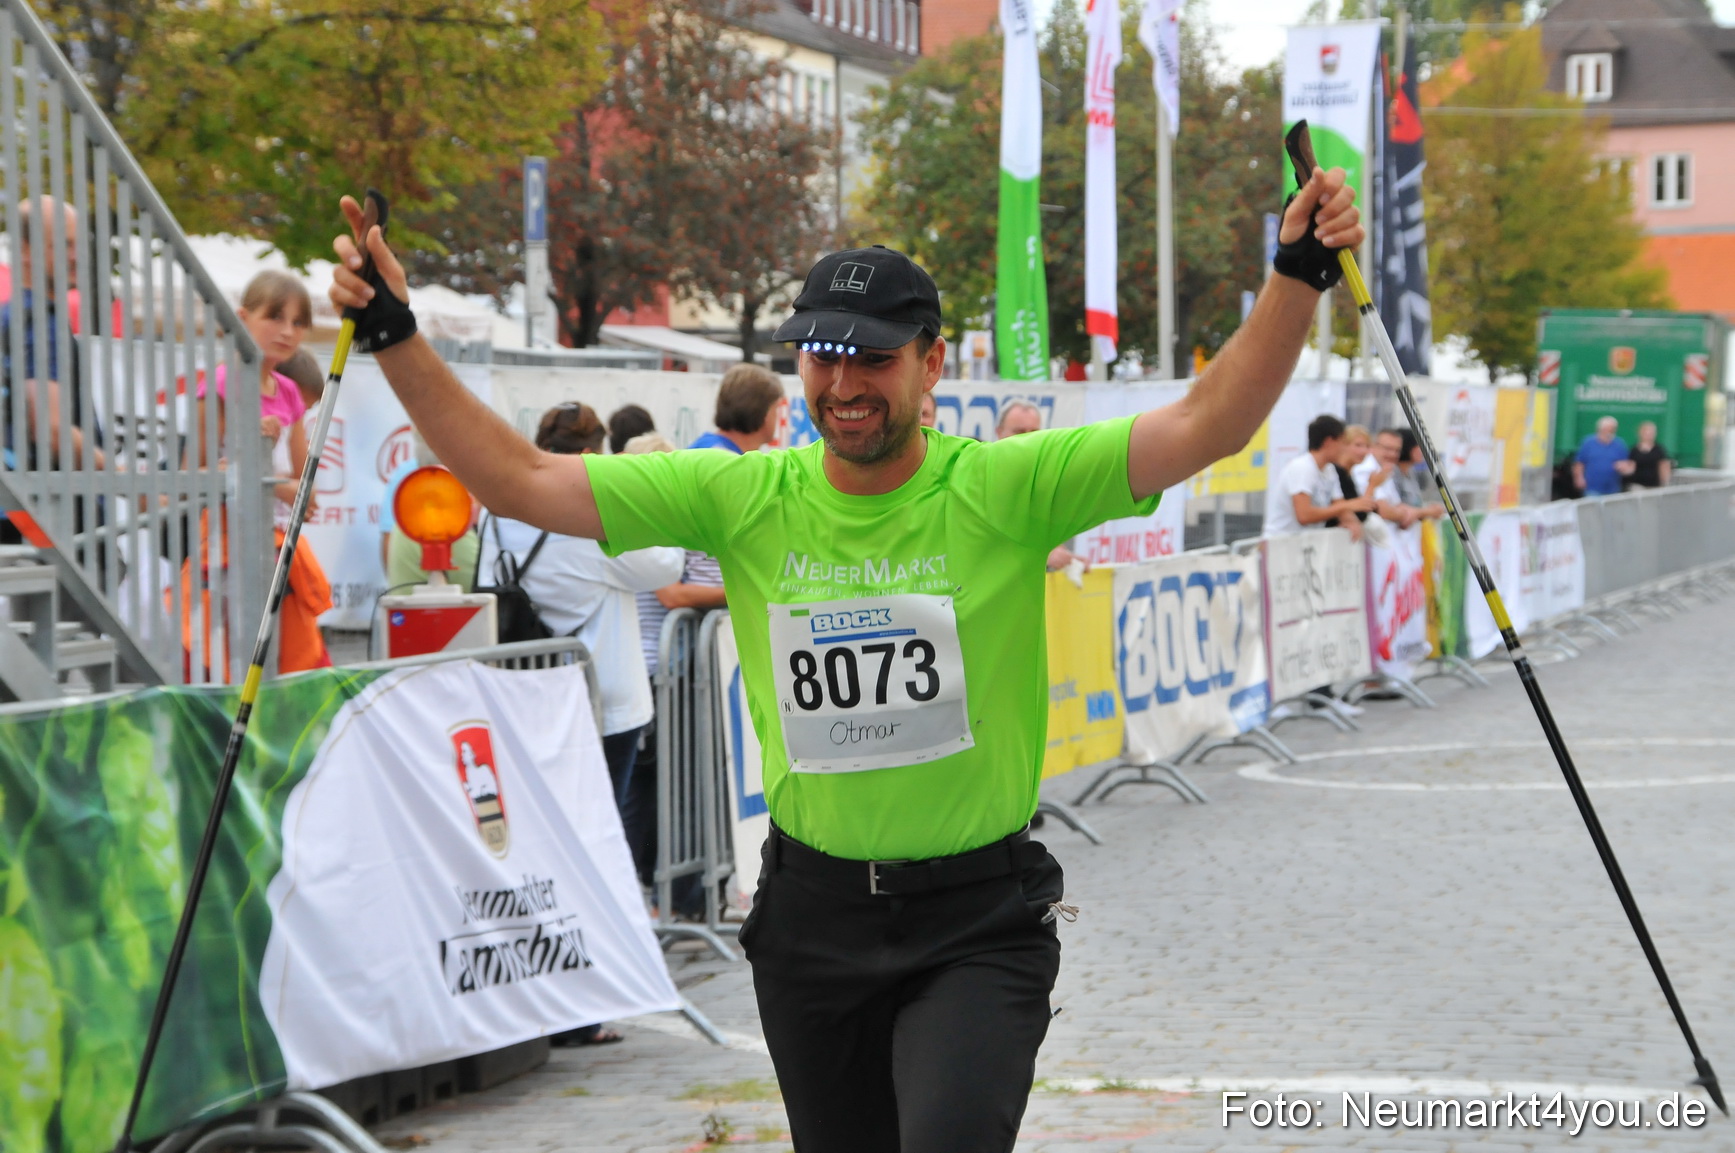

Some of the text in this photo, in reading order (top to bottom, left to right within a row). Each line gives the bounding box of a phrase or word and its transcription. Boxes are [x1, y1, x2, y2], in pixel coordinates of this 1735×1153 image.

[309, 506, 356, 525] EAT
[811, 608, 892, 633] BOCK
[1118, 571, 1244, 715] BOCK
[789, 638, 941, 712] 8073
[829, 720, 902, 746] Otmar
